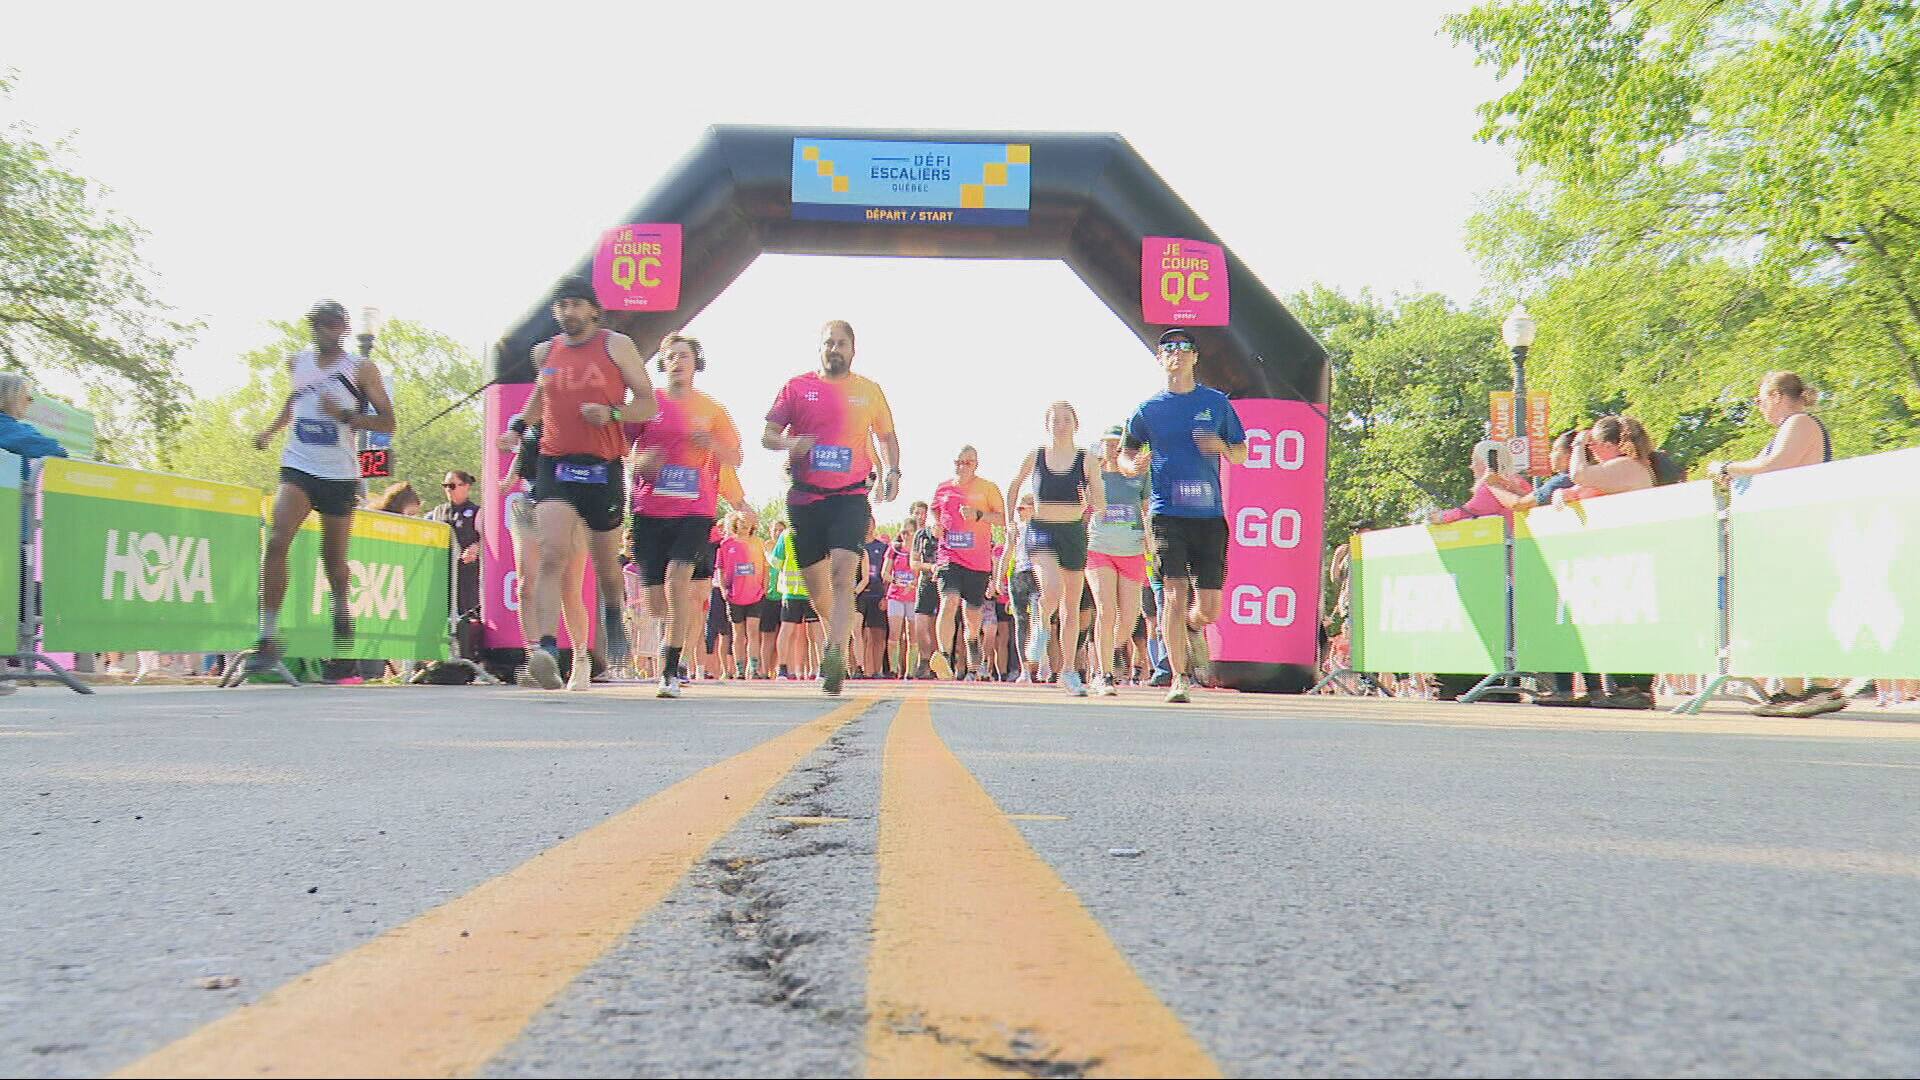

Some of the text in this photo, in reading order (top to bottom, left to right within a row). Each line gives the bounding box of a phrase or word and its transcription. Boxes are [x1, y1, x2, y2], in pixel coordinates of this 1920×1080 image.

[914, 152, 951, 167] DÉFI
[870, 167, 951, 181] ESCALIERS
[892, 182, 929, 193] QUÉBEC
[866, 208, 907, 220] DÉPART
[919, 211, 954, 221] START
[614, 243, 662, 255] COURS
[1163, 243, 1180, 256] JE
[612, 256, 662, 291] QC
[1161, 257, 1210, 271] COURS
[1161, 271, 1211, 305] QC
[1243, 428, 1305, 471] GO
[359, 450, 390, 477] 02
[1235, 507, 1302, 549] GO
[102, 529, 216, 603] HOKA
[312, 558, 408, 621] HOKA
[1230, 584, 1297, 627] GO
